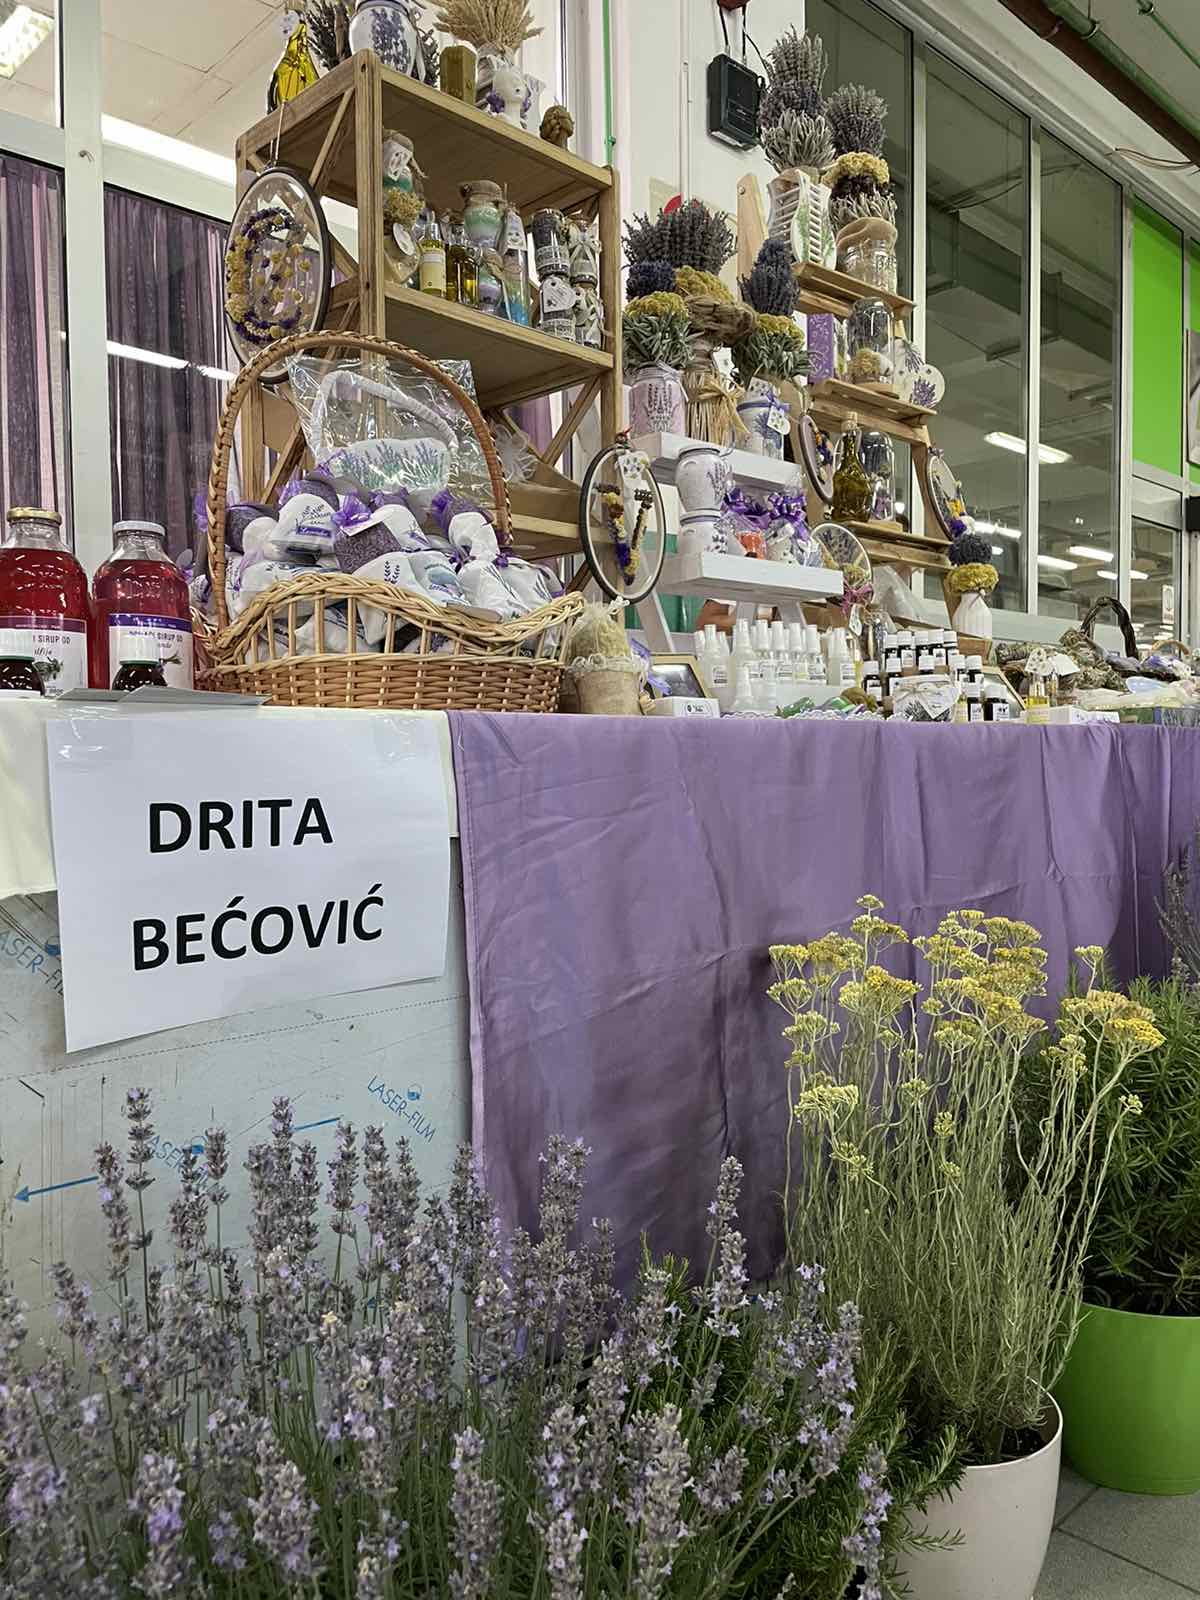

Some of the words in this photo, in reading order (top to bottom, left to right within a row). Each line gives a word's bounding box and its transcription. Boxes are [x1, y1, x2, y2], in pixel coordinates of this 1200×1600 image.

[38, 635, 60, 644] SIRUP
[149, 798, 334, 854] DRITA
[133, 883, 385, 971] BEĆOVIĆ
[367, 1074, 437, 1143] LASER-FILM
